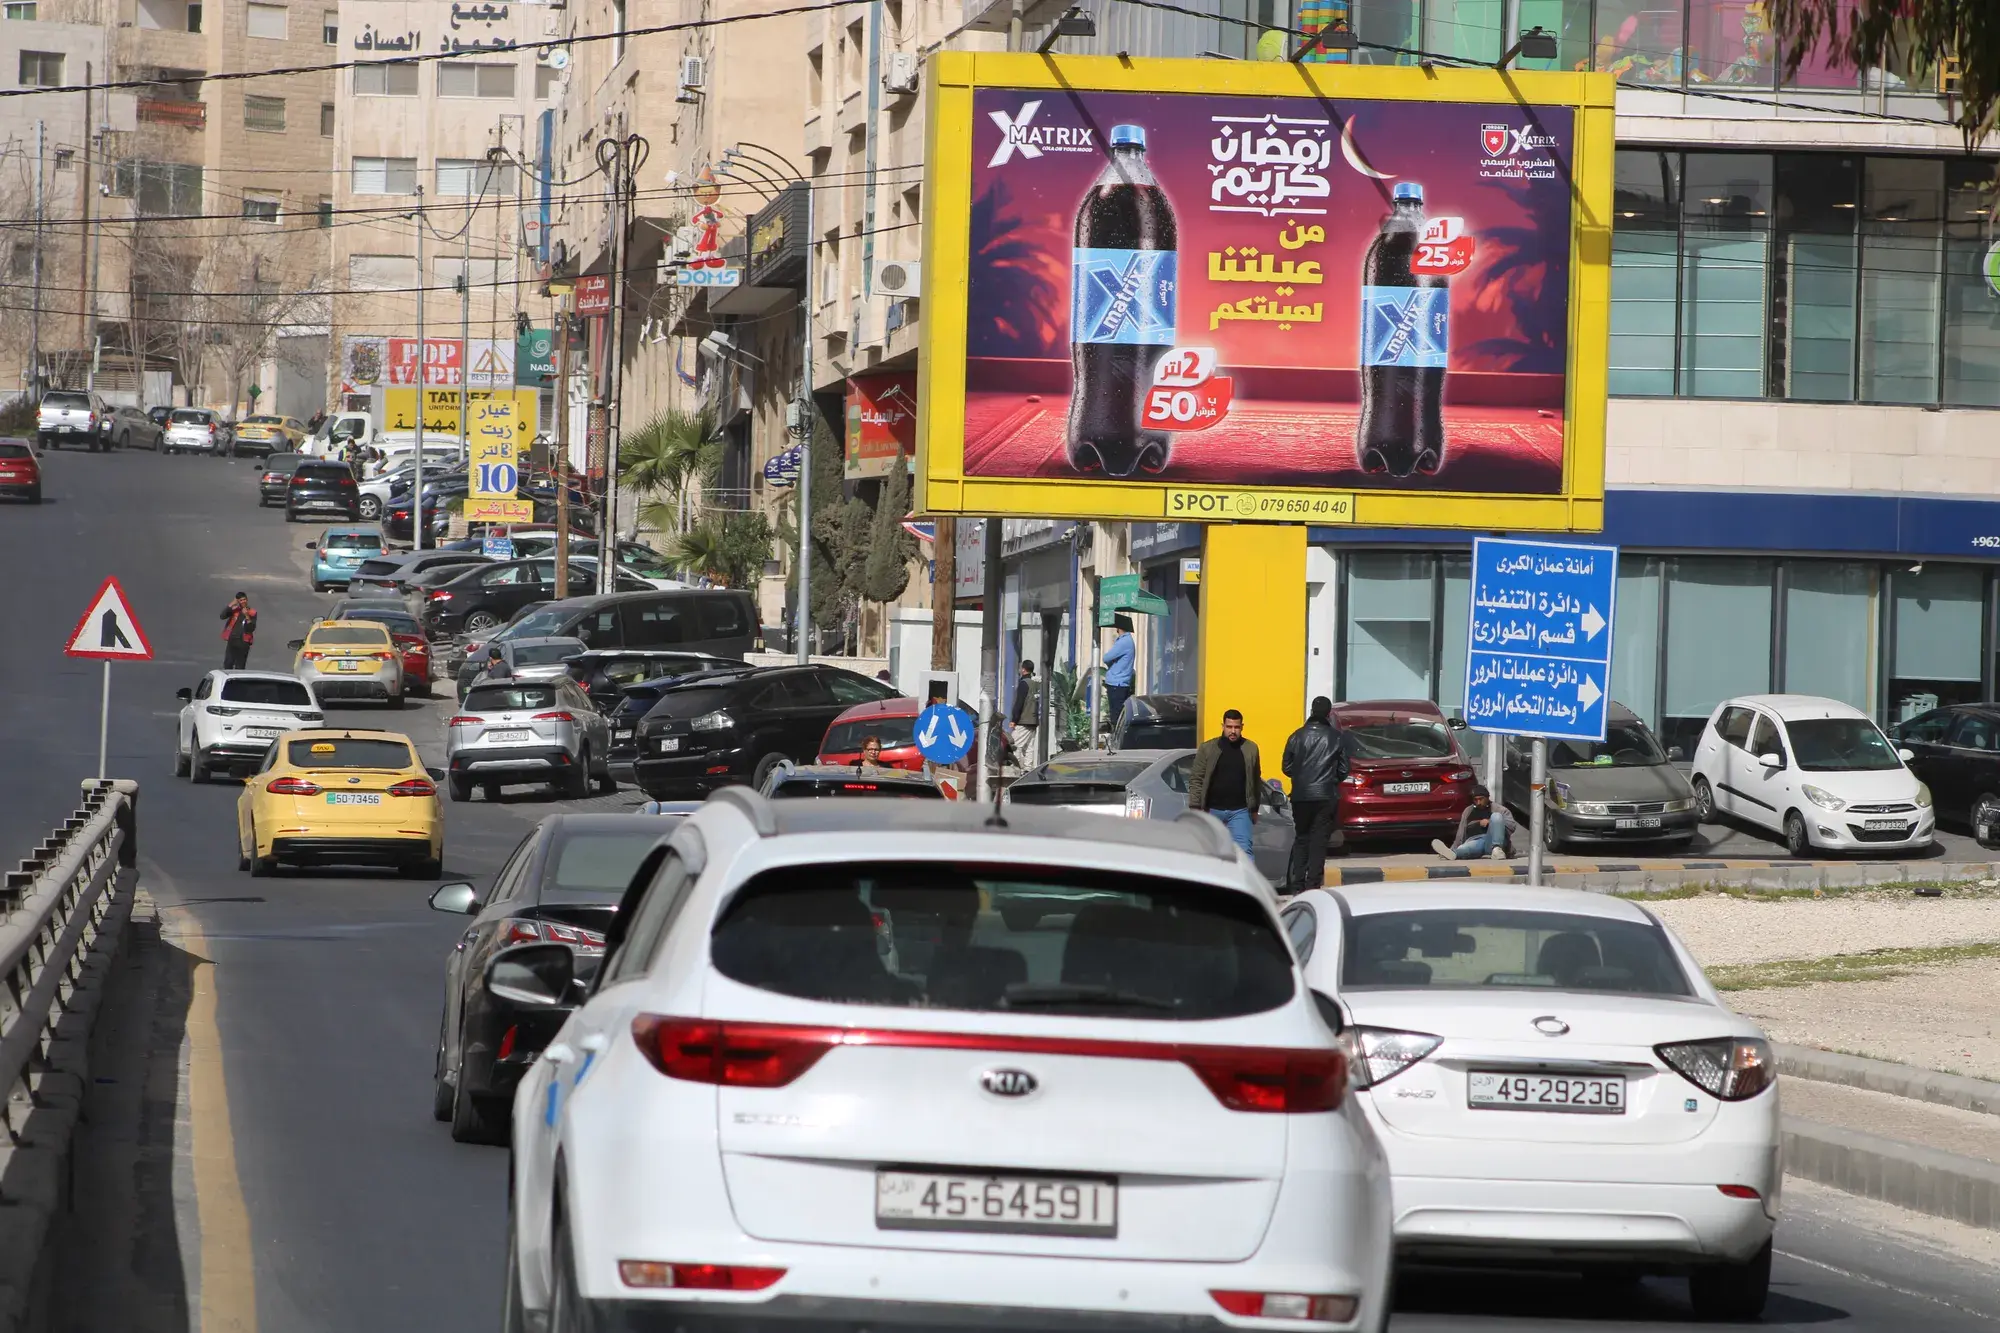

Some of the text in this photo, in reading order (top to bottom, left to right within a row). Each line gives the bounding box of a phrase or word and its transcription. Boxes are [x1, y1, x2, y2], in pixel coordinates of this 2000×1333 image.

[451, 3, 508, 30] مجمع
[354, 23, 421, 51] العساف
[440, 34, 517, 52] محمود
[1010, 125, 1093, 145] MATRIX
[1211, 124, 1331, 170] رمضان
[1518, 135, 1556, 145] MATRIX
[1480, 158, 1555, 169] المشروب الرسمي
[1525, 171, 1555, 180] لمنتخب
[1207, 163, 1331, 205] كريم
[1279, 219, 1325, 250] من
[1425, 220, 1448, 240] 1 لتر
[1417, 246, 1449, 267] 25
[1450, 259, 1465, 267] قرش
[1208, 246, 1324, 297] عيلتنا
[1102, 268, 1146, 331] matrix
[1209, 296, 1324, 331] لعيلتكم
[1387, 304, 1424, 356] matrix
[402, 343, 456, 364] POP
[1160, 351, 1200, 381] 2 لتر
[476, 404, 511, 419] غيار
[1148, 391, 1197, 421] 50
[1195, 407, 1217, 417] قرش
[1207, 397, 1217, 406] ب
[480, 425, 512, 439] زيت
[478, 445, 498, 460] لتر
[477, 463, 517, 493] 10
[1173, 493, 1347, 514] SPOT 079 650 40 40
[1496, 555, 1594, 575] أمانة عمان الكبرى
[1476, 584, 1580, 618] دائرة التنفيذ
[1474, 620, 1576, 648] قسم الطوارئ
[1470, 658, 1578, 689] دائرة عمليات المرور
[1469, 691, 1577, 725] وحدة التحكم المروري
[336, 794, 380, 804] 50-73456
[989, 1073, 1030, 1093] KIA
[1497, 1078, 1619, 1105] 49-29236
[920, 1181, 1099, 1221] 45-64591
